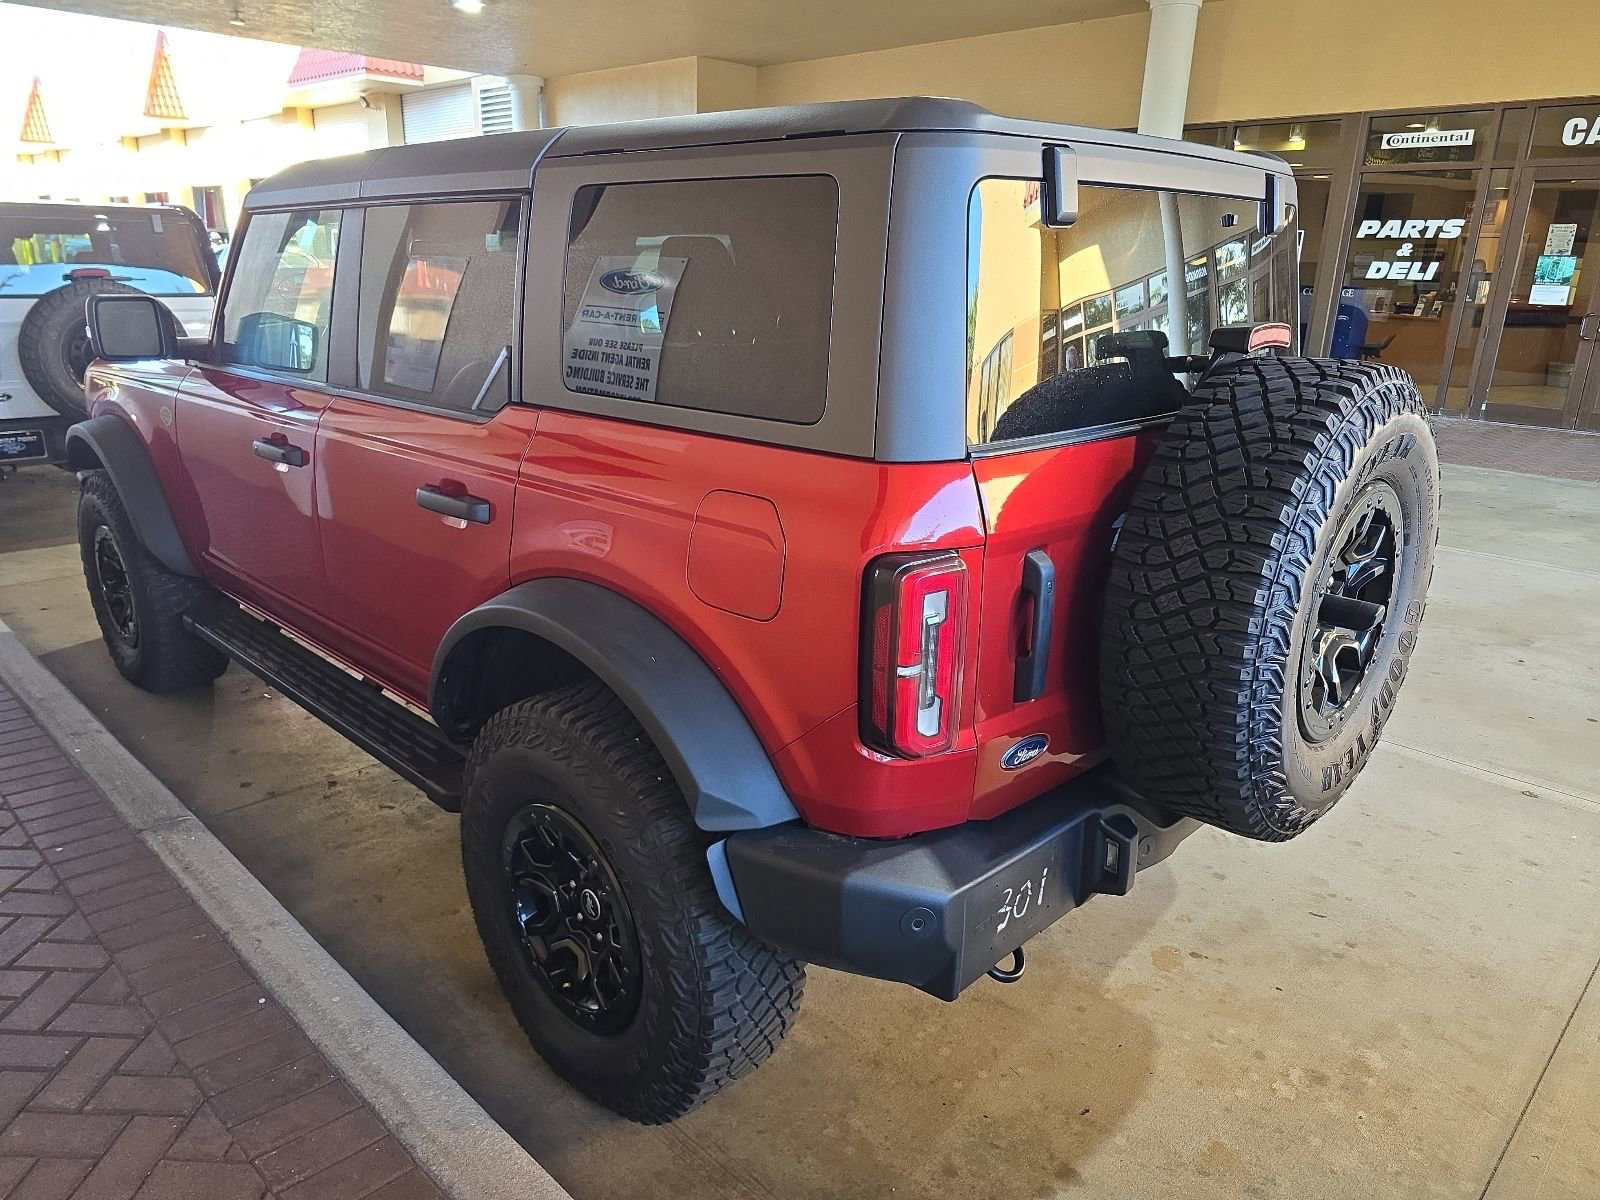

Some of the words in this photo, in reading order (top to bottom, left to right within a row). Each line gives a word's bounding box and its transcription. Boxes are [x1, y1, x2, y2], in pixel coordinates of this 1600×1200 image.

[1386, 132, 1470, 147] Continental
[1356, 219, 1466, 238] PARTS
[1396, 243, 1414, 257] &
[1365, 261, 1440, 280] DELI
